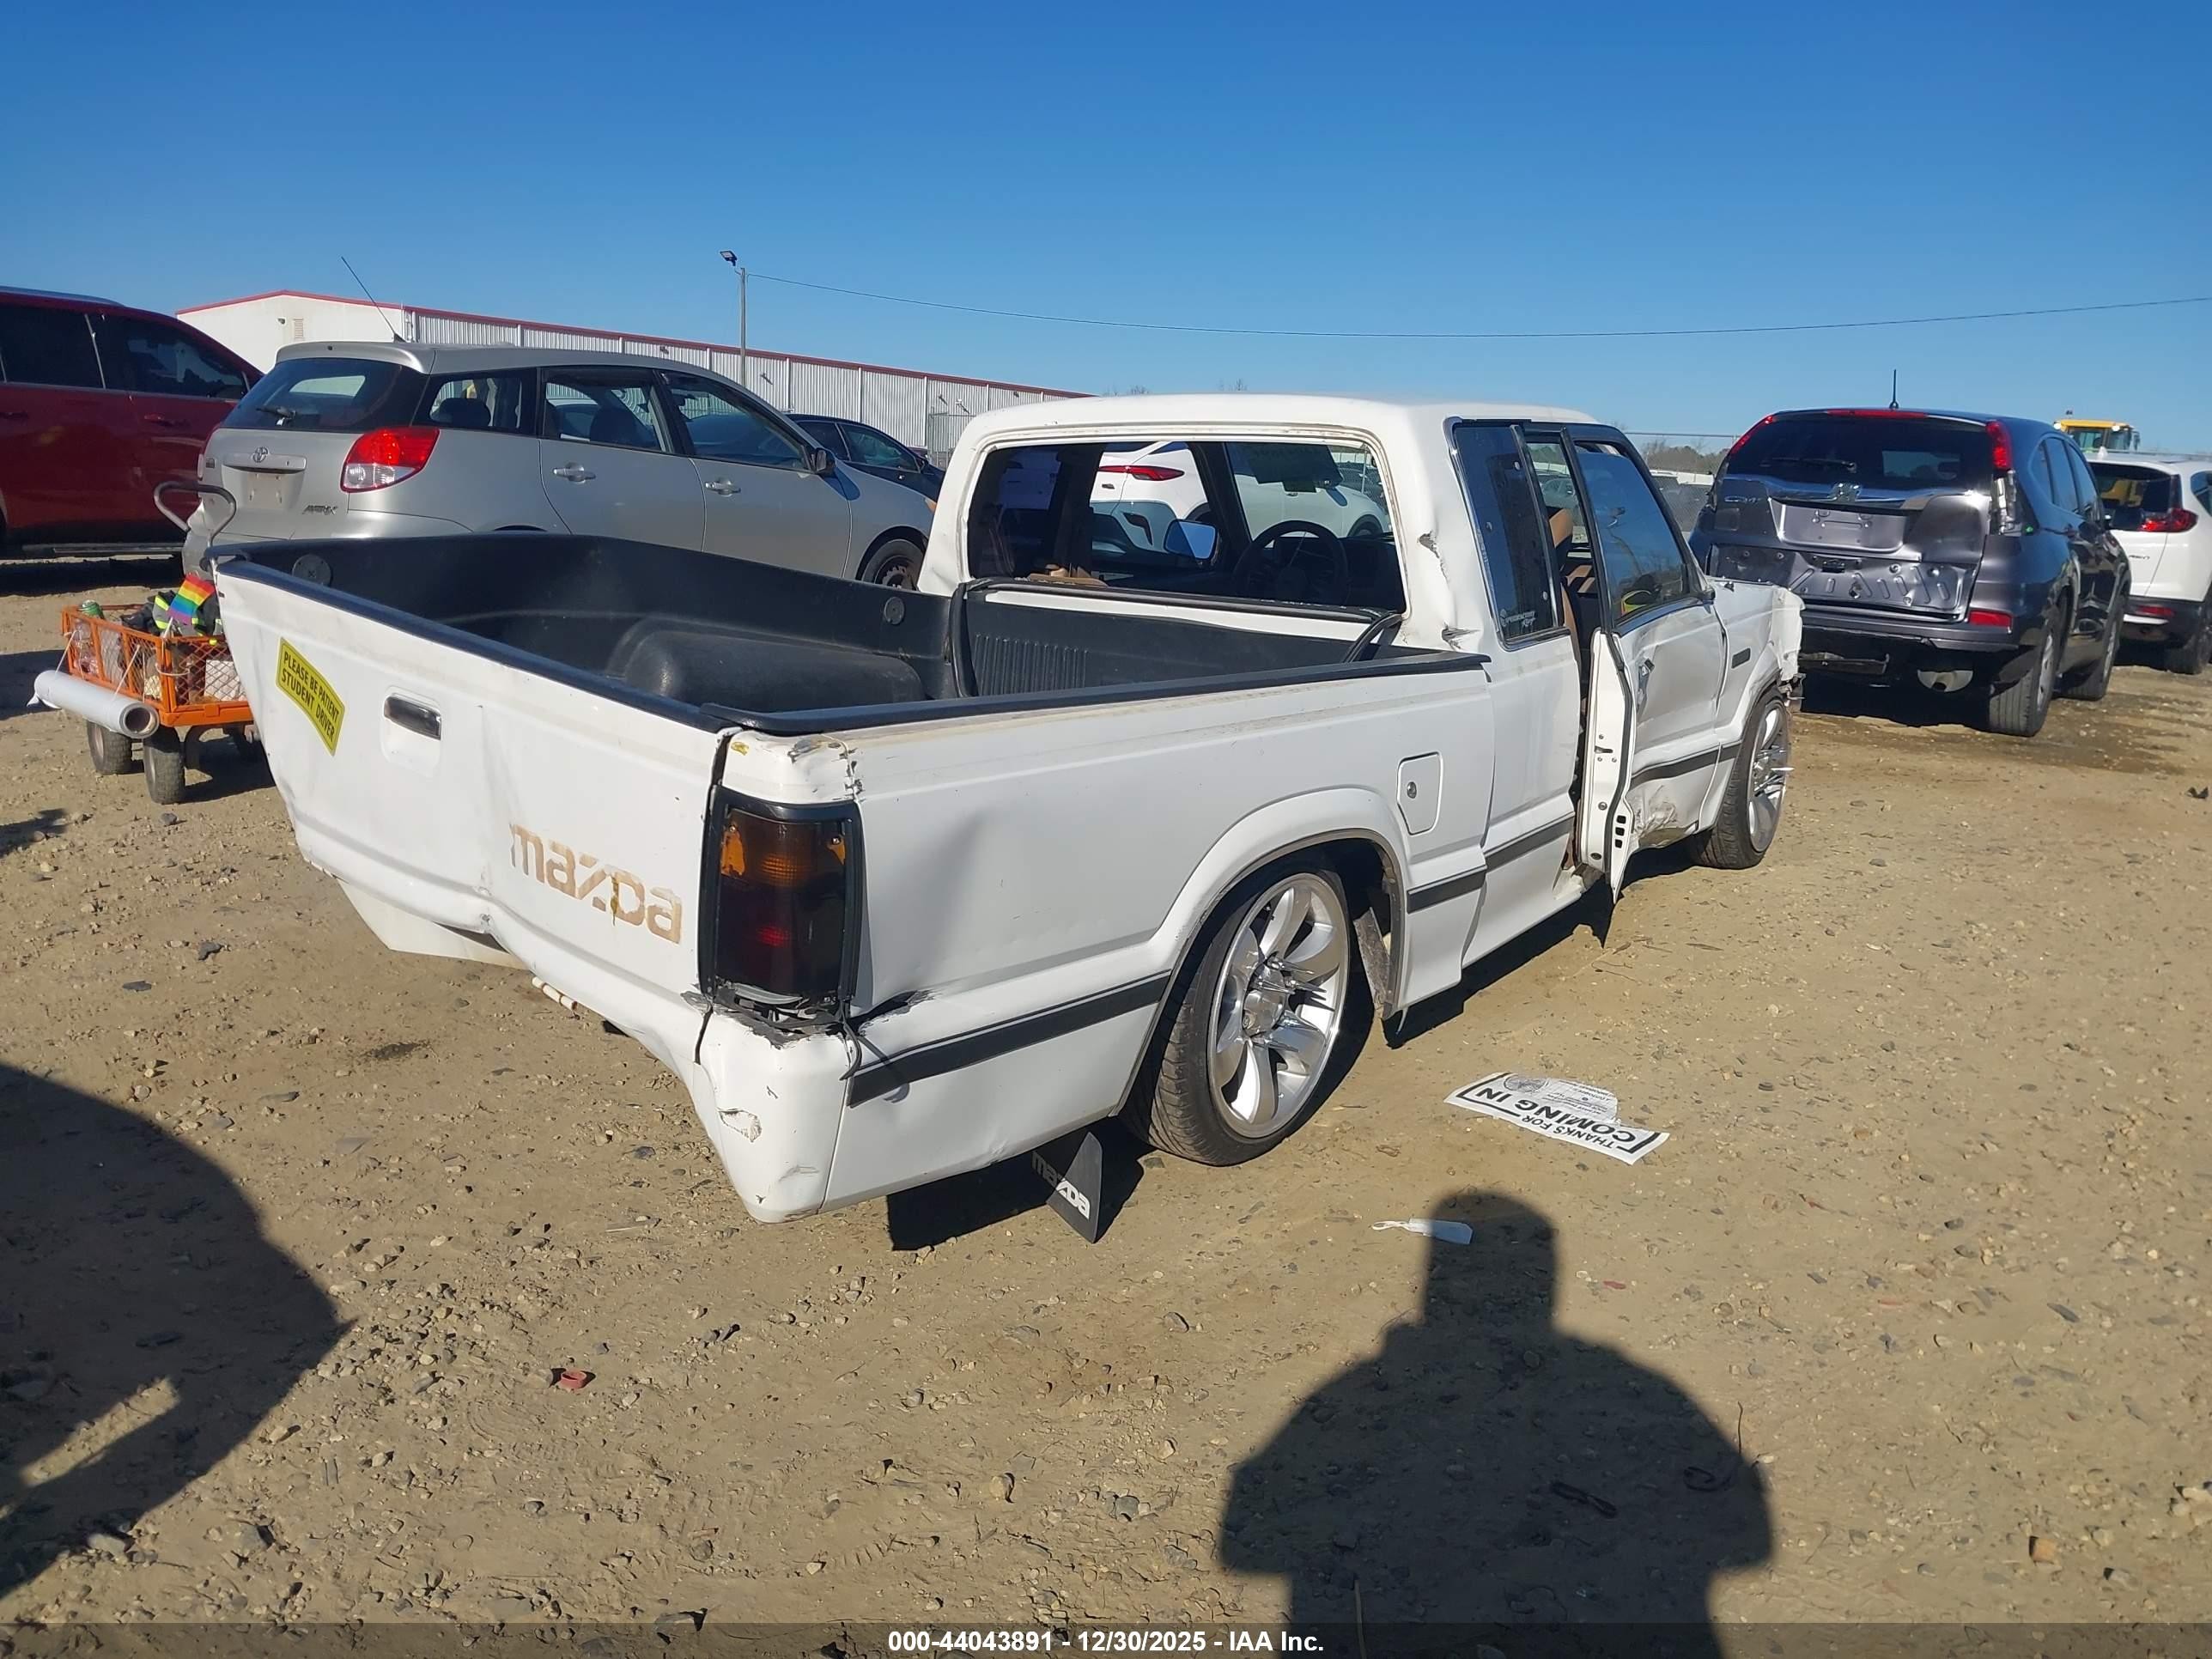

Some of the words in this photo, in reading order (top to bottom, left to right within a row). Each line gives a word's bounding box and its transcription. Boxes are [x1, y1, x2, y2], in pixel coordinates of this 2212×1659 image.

[283, 651, 308, 683] PLEASE
[309, 674, 319, 695] BE
[319, 685, 340, 723] PATIENT
[281, 669, 315, 711] STUDENT
[315, 704, 335, 743] DRIVER
[1475, 1087, 1513, 1103] IN
[1514, 1099, 1638, 1143] COMING
[1521, 1115, 1553, 1131] FOR
[1553, 1125, 1614, 1149] THANKS
